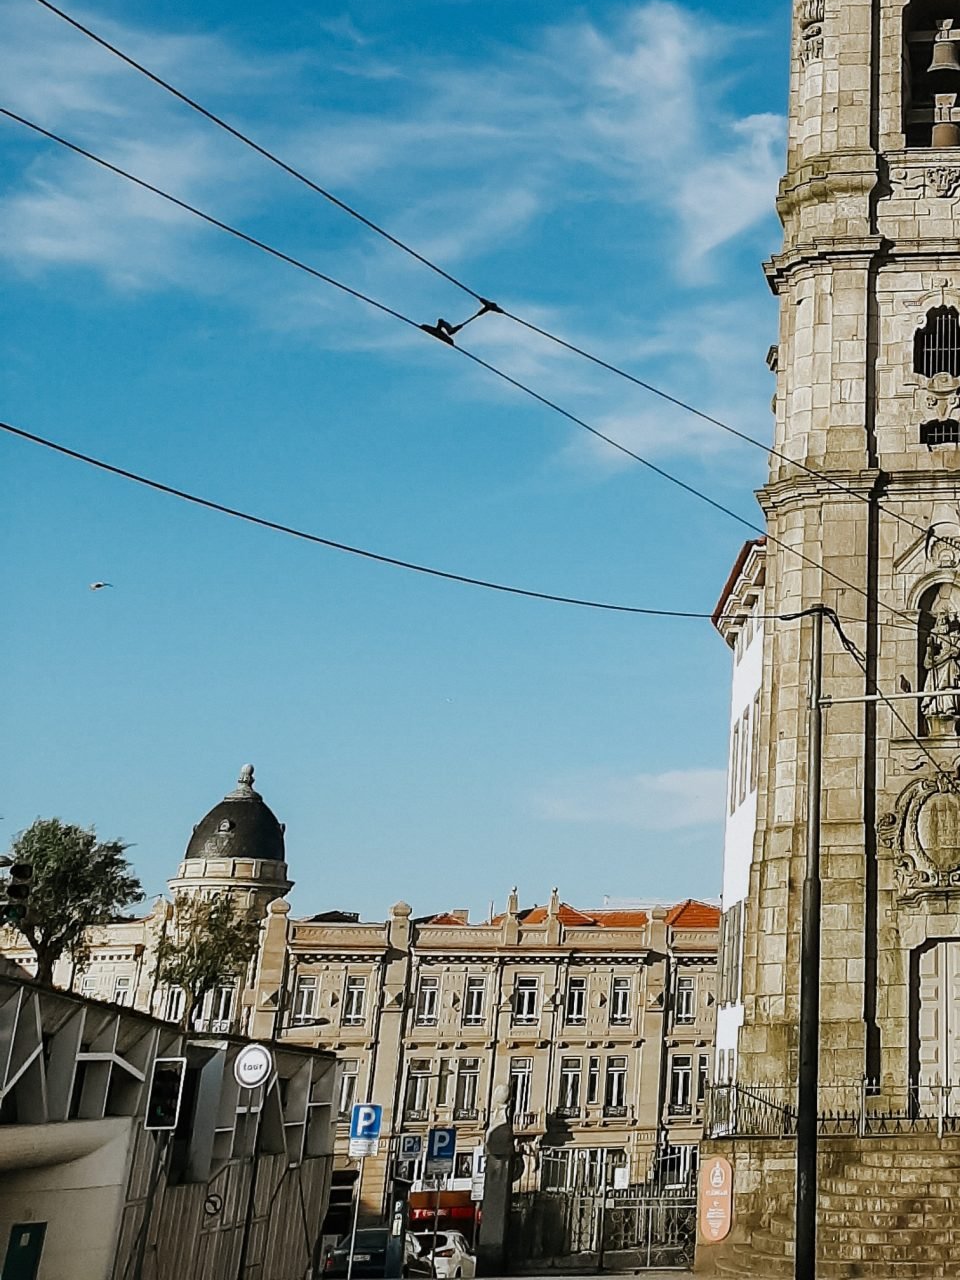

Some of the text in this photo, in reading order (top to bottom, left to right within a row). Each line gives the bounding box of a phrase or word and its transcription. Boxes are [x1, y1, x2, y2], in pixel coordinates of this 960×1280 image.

[358, 1107, 376, 1136] P
[404, 1138, 414, 1152] P
[433, 1131, 450, 1156] P
[395, 1201, 402, 1212] P
